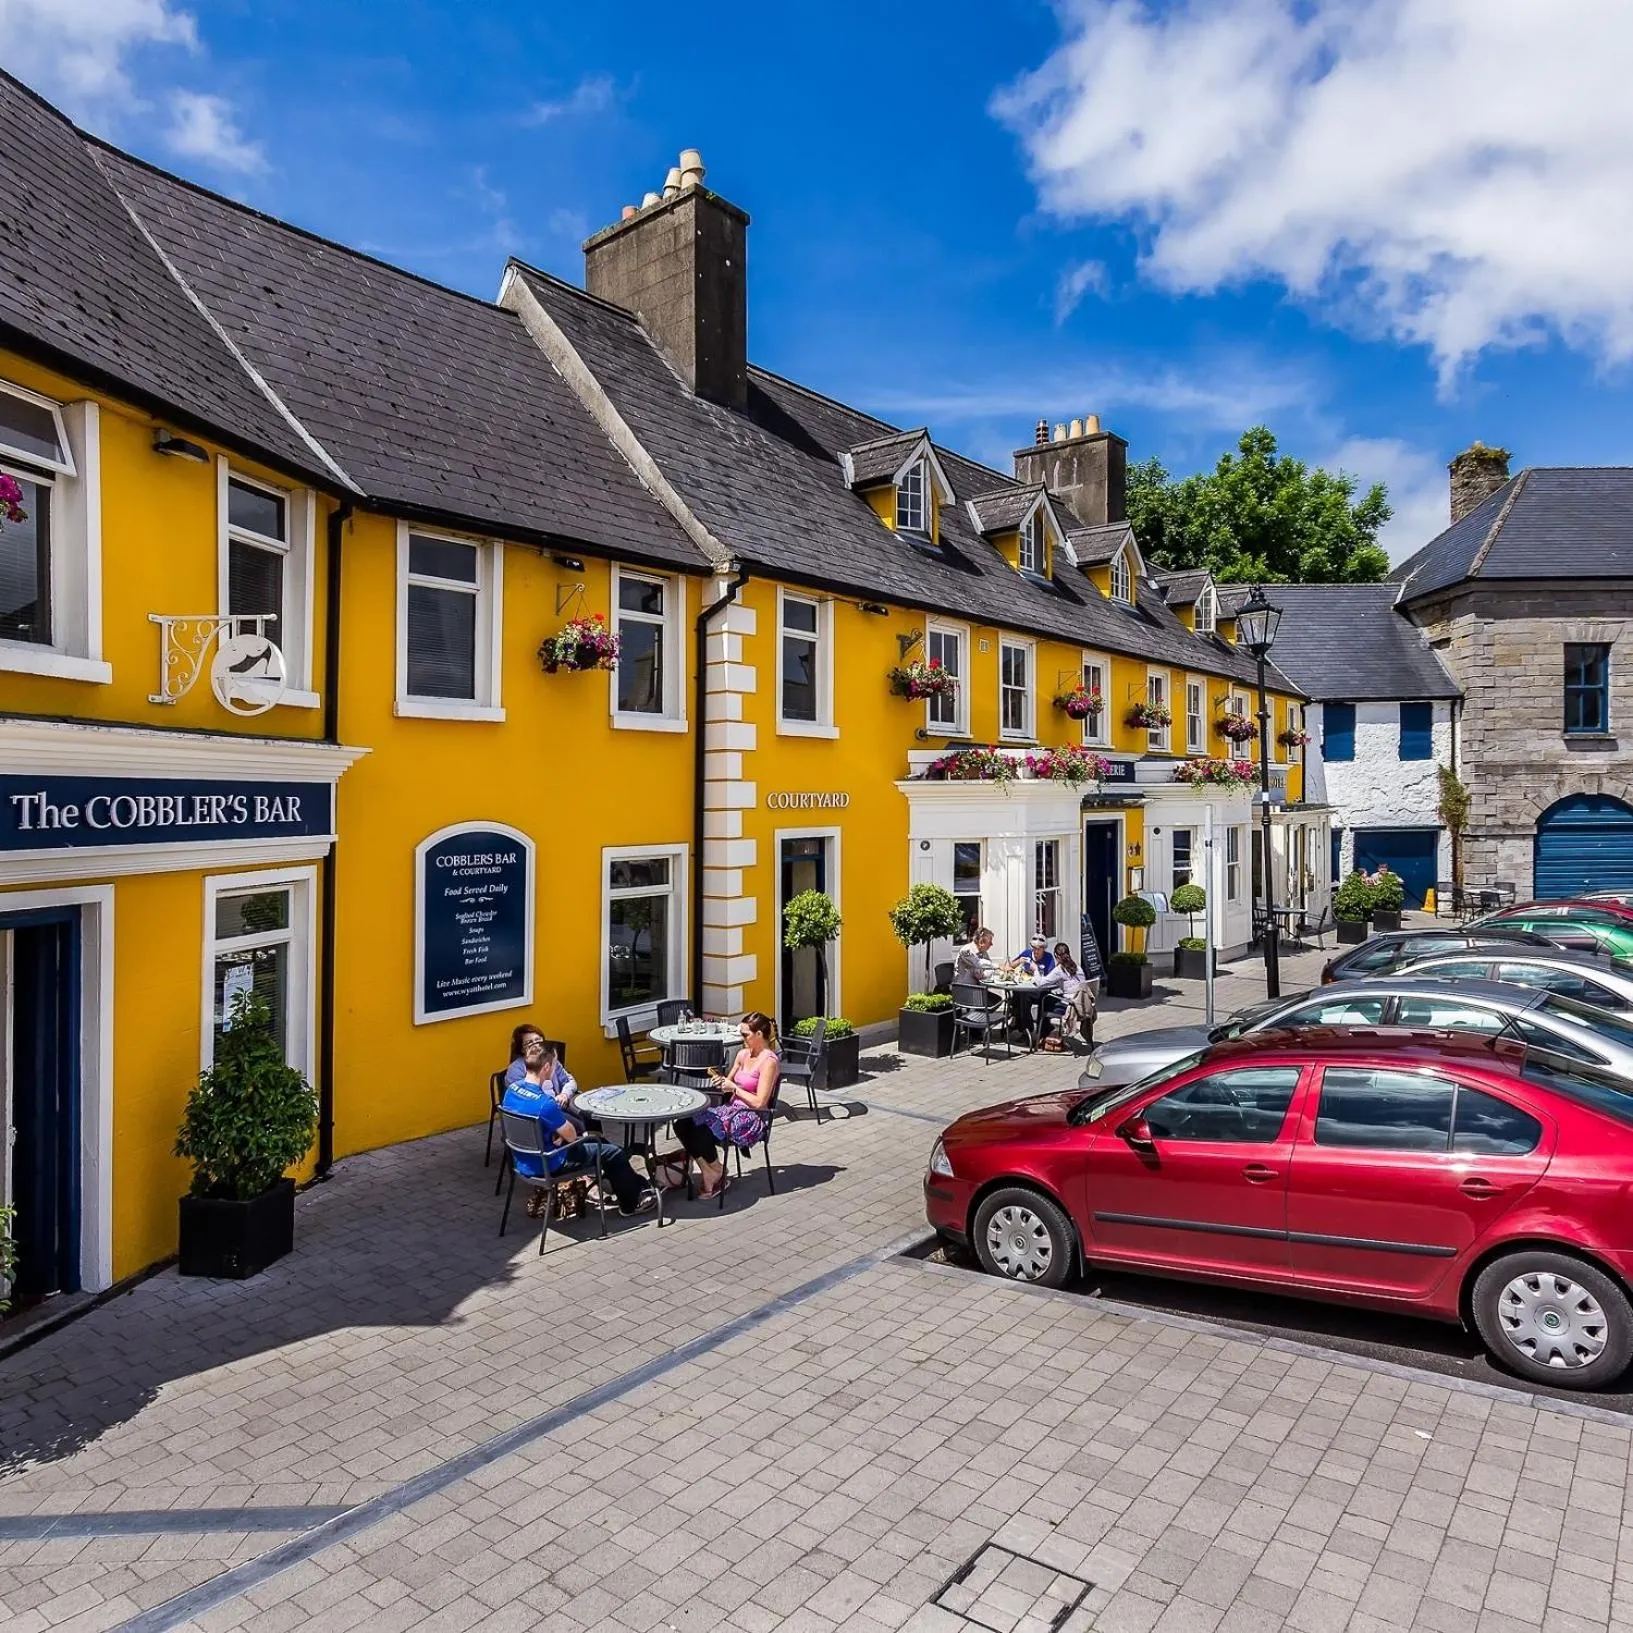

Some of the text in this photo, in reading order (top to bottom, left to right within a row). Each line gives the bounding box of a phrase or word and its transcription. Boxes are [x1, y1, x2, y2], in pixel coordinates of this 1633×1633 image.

[767, 792, 850, 809] COURTYARD
[9, 791, 302, 829] The COBBLER'S BAR
[436, 853, 517, 868] COBBLERS BAR
[459, 866, 502, 876] COURTYARD
[444, 884, 508, 896] Food Served Daily
[436, 970, 513, 988] Live Music every weekend
